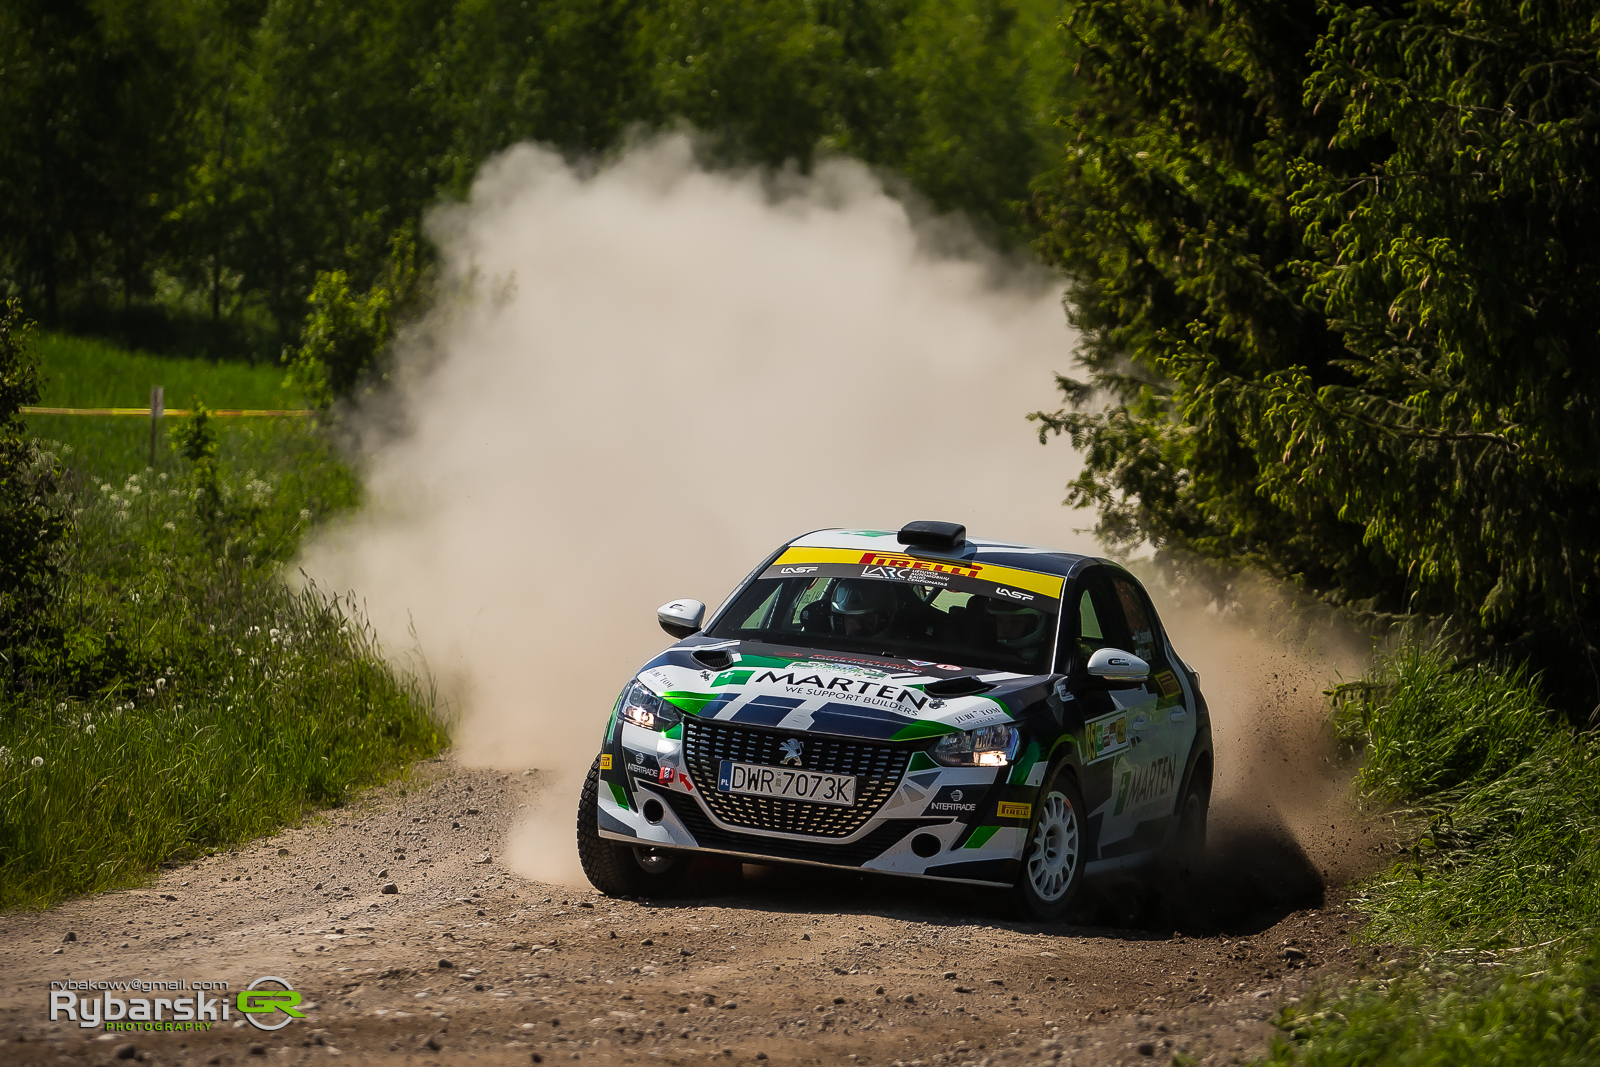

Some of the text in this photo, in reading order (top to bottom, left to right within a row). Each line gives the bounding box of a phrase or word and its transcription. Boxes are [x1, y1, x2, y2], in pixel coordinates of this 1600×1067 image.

[780, 566, 819, 574] LASF
[859, 552, 983, 578] PIRELLI
[861, 565, 911, 579] LARC
[995, 586, 1035, 601] LASF
[754, 670, 929, 711] MARTEN
[785, 686, 919, 717] WE SUPPORT BUILDERS
[627, 763, 658, 778] INTERTRADE
[720, 766, 852, 802] PL DWR 7073K
[1126, 752, 1177, 808] MARTEN
[931, 802, 976, 811] INTERTRADE
[1001, 804, 1029, 816] PIRELLI
